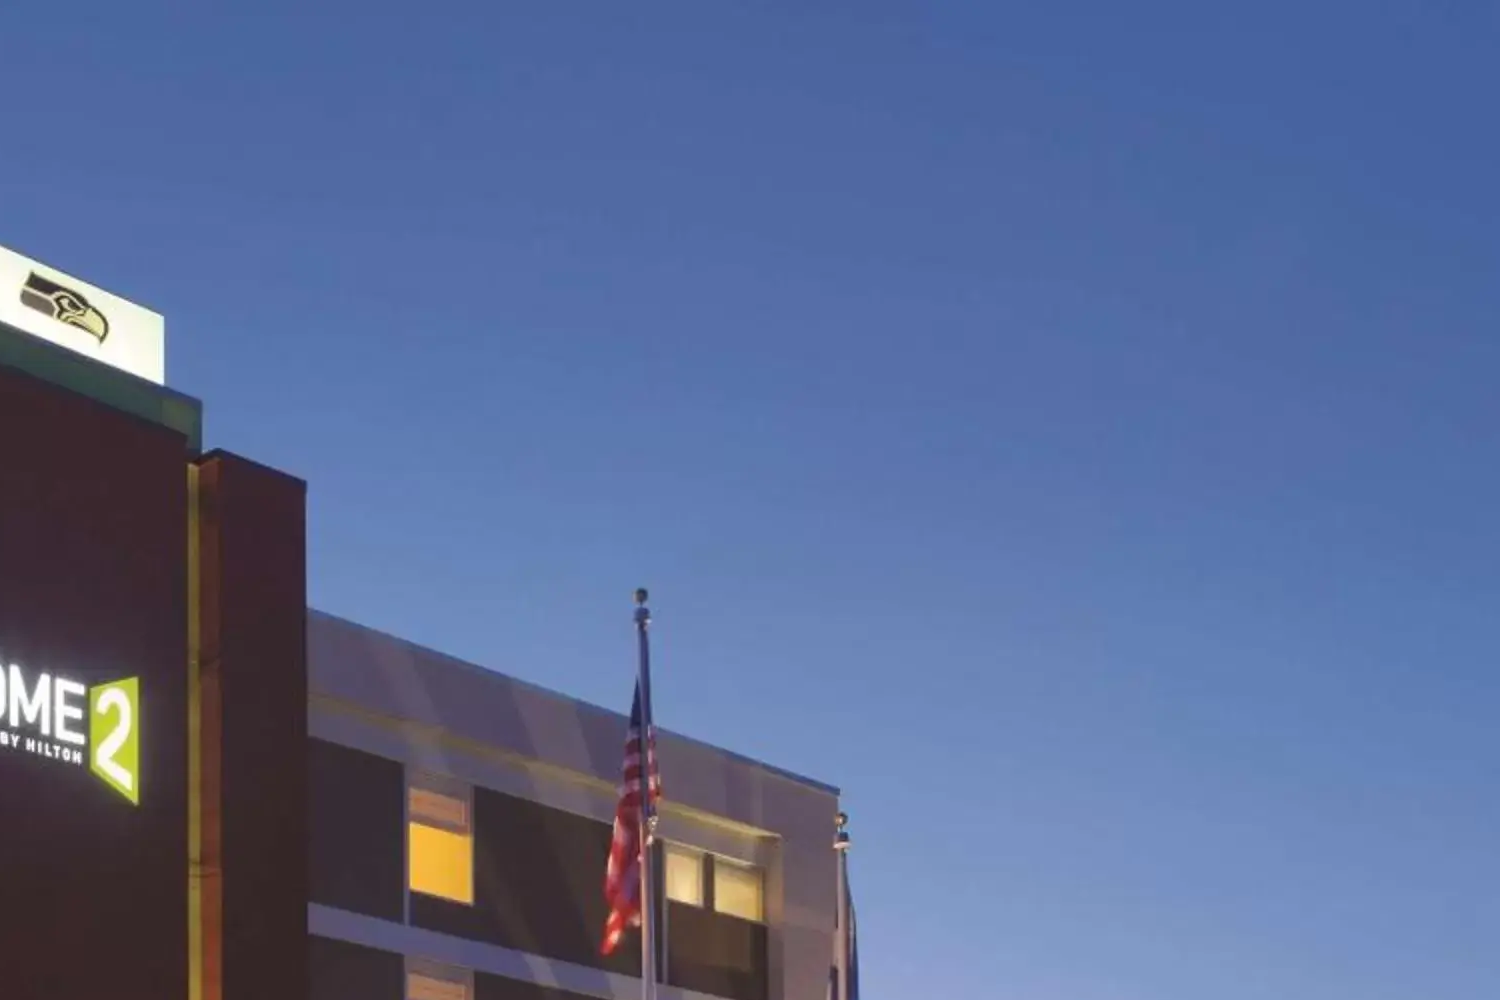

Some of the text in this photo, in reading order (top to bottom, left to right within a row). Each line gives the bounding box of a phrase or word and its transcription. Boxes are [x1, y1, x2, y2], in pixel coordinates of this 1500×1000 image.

[0, 731, 20, 749] BY
[26, 738, 83, 766] HILTON
[96, 687, 133, 791] 2
